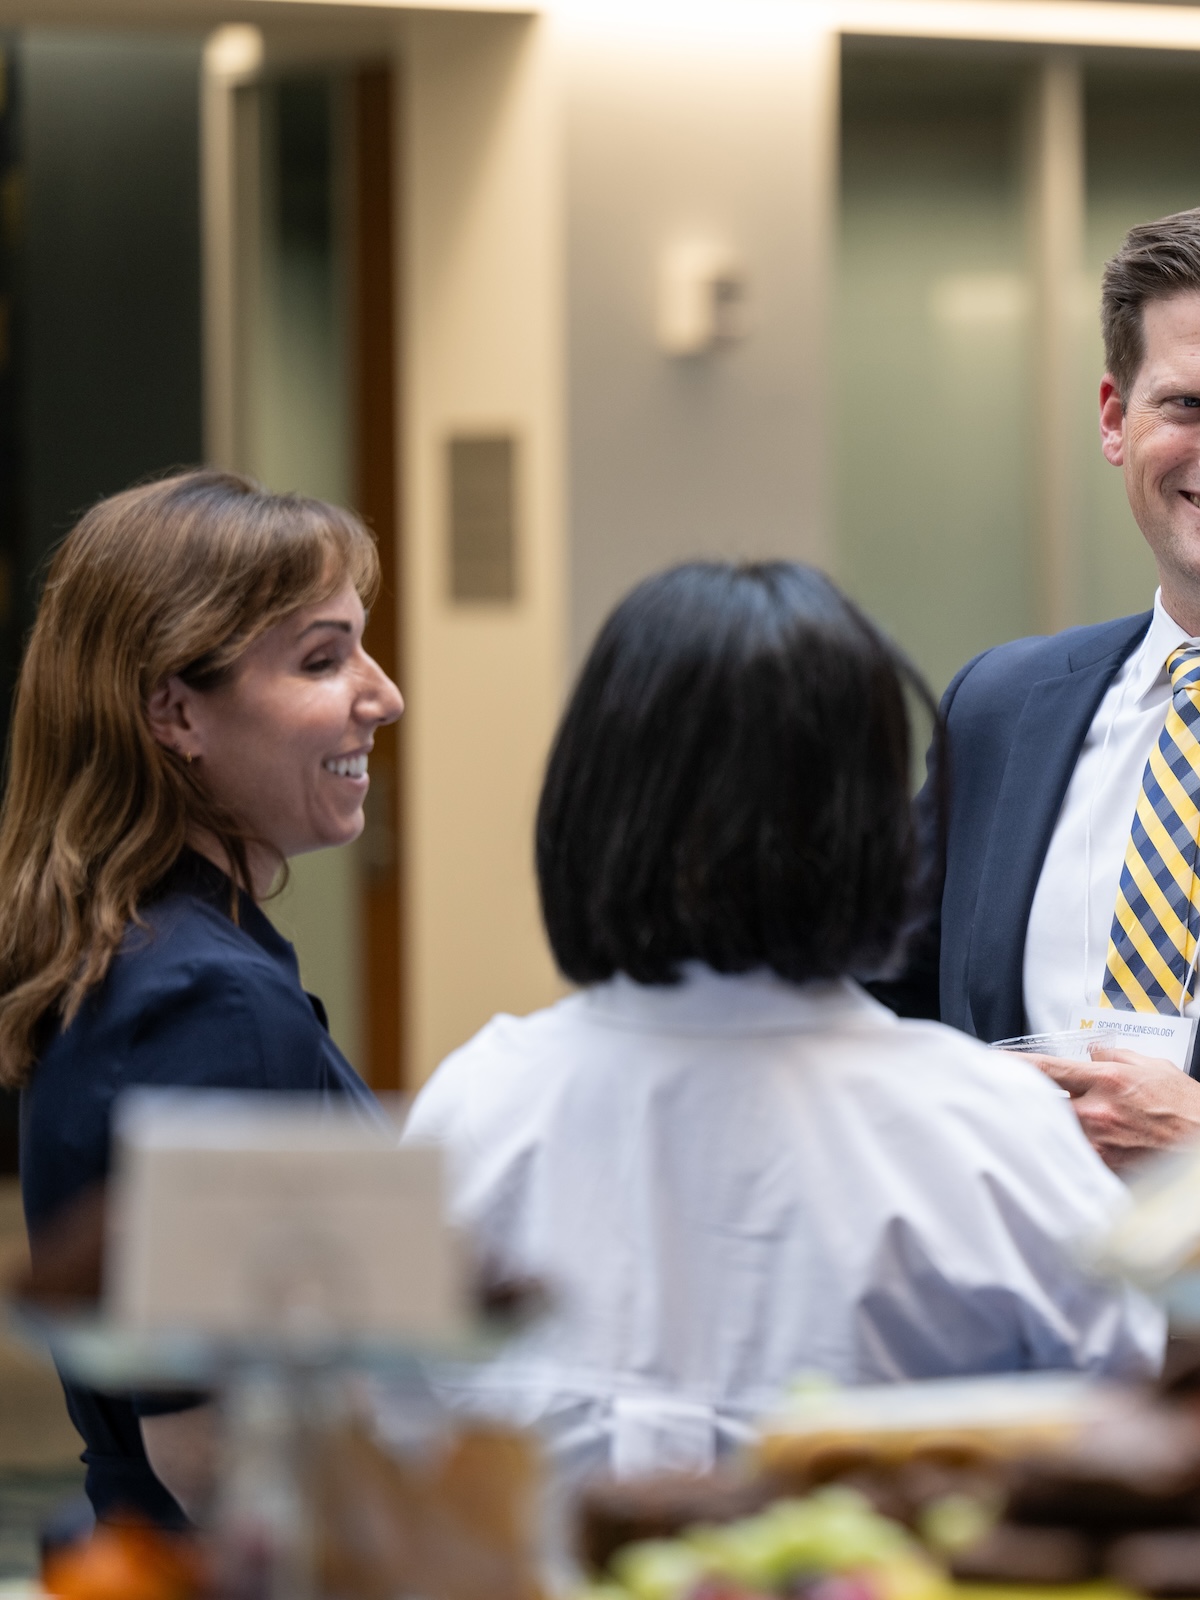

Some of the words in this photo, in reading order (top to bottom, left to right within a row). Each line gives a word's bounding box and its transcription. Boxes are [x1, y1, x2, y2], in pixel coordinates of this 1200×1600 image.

[1080, 1019, 1094, 1029] M
[1098, 1021, 1122, 1031] SCHOOL
[1124, 1024, 1133, 1032] OF
[1133, 1025, 1175, 1037] KINESIOLOGY
